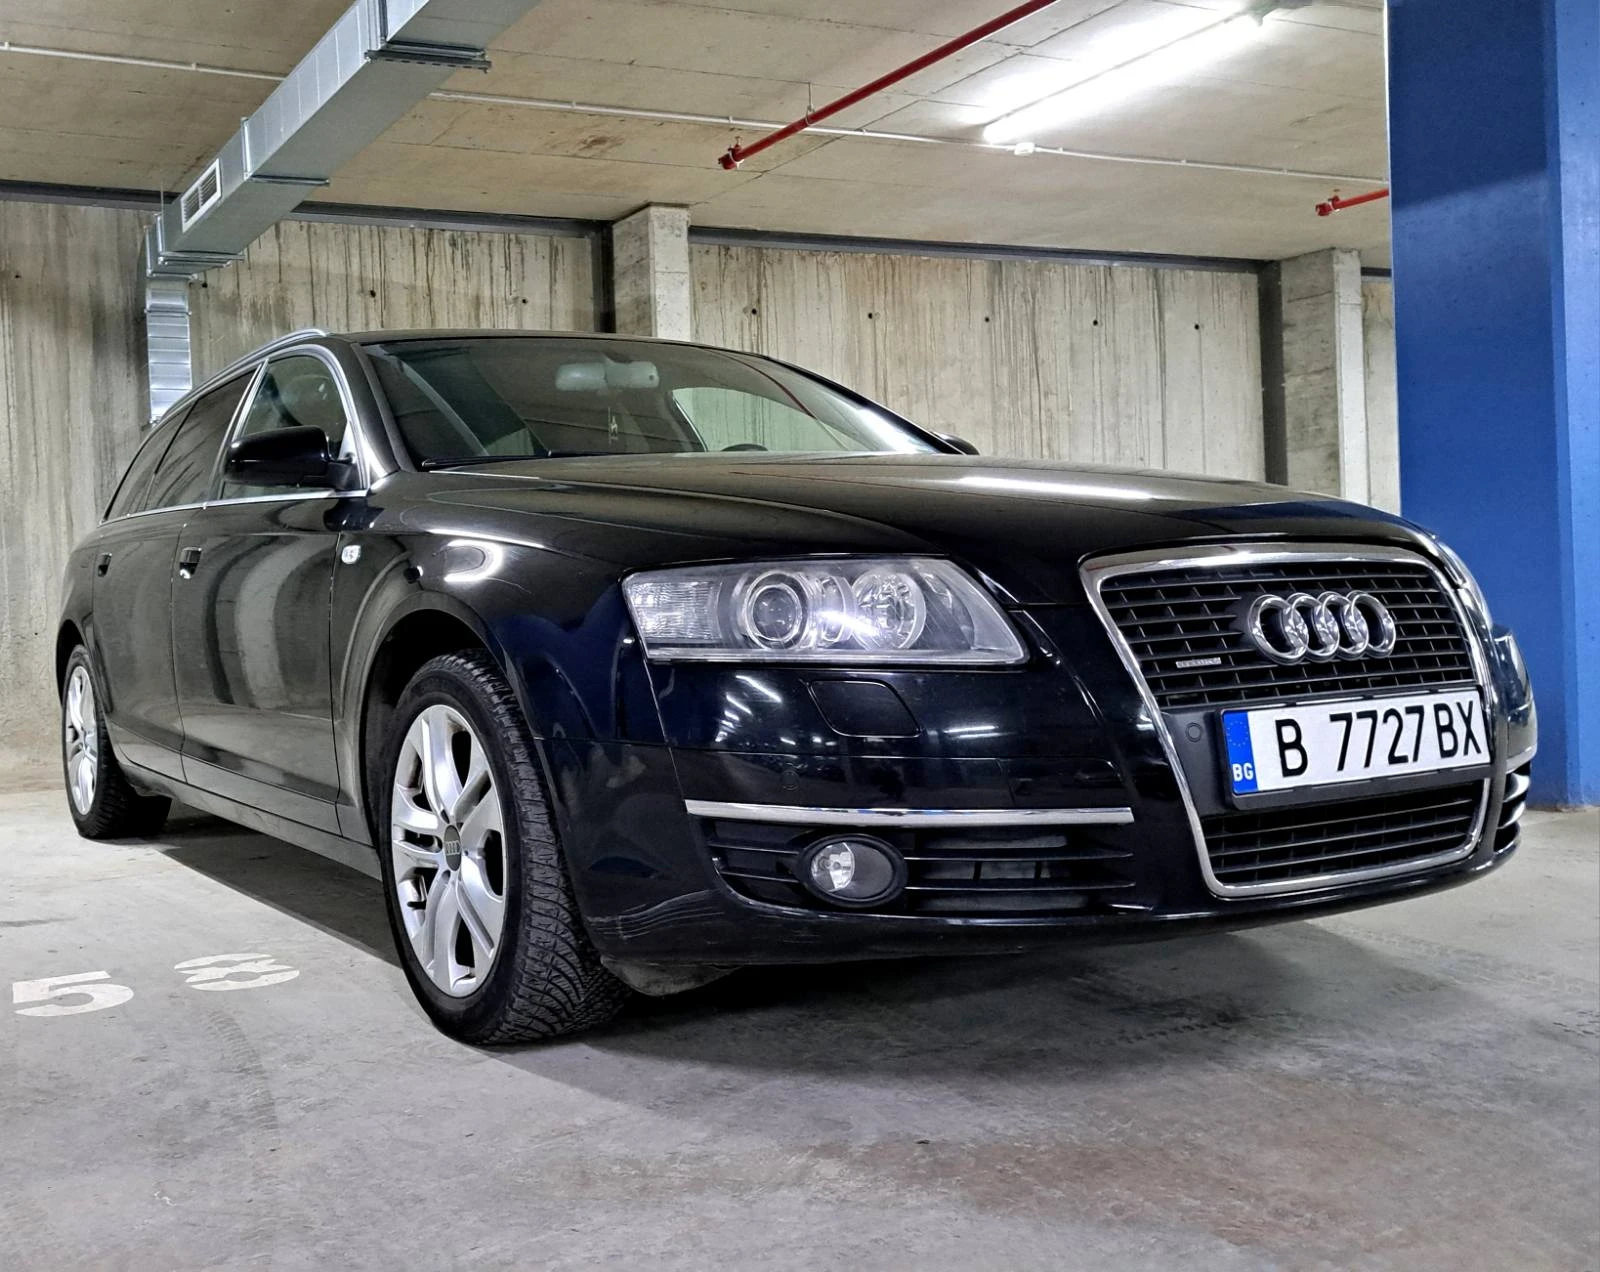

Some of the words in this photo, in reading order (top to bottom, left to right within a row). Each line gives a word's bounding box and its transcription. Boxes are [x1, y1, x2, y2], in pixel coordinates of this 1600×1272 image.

[1275, 718, 1308, 777] B
[1329, 705, 1424, 771] 7727
[1434, 700, 1481, 759] BX
[1232, 763, 1254, 781] BG
